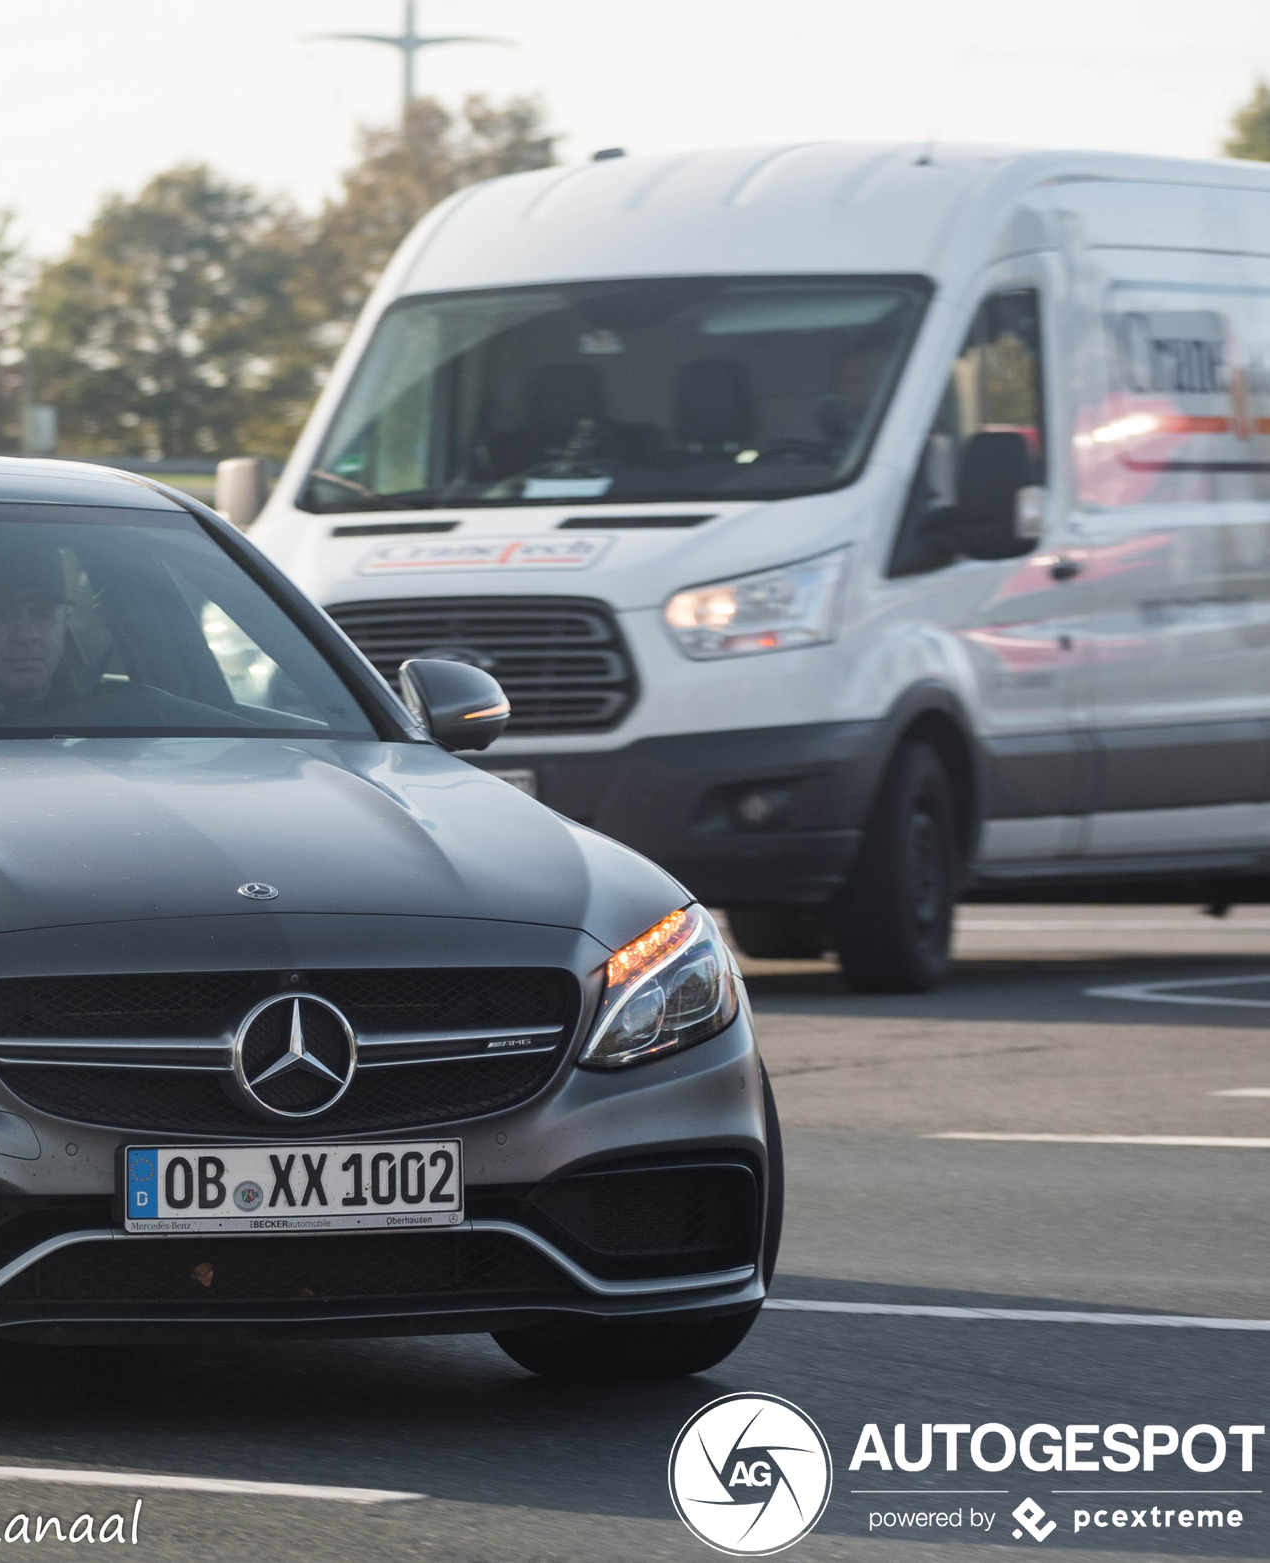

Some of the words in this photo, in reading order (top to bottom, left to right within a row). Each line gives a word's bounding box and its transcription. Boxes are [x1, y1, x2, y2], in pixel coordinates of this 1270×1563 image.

[165, 1155, 227, 1210] OB
[268, 1153, 329, 1207] XX
[341, 1150, 456, 1207] 1002
[136, 1190, 149, 1207] D
[131, 1221, 191, 1230] Mercedes-Benz
[386, 1215, 433, 1226] Oberhausen
